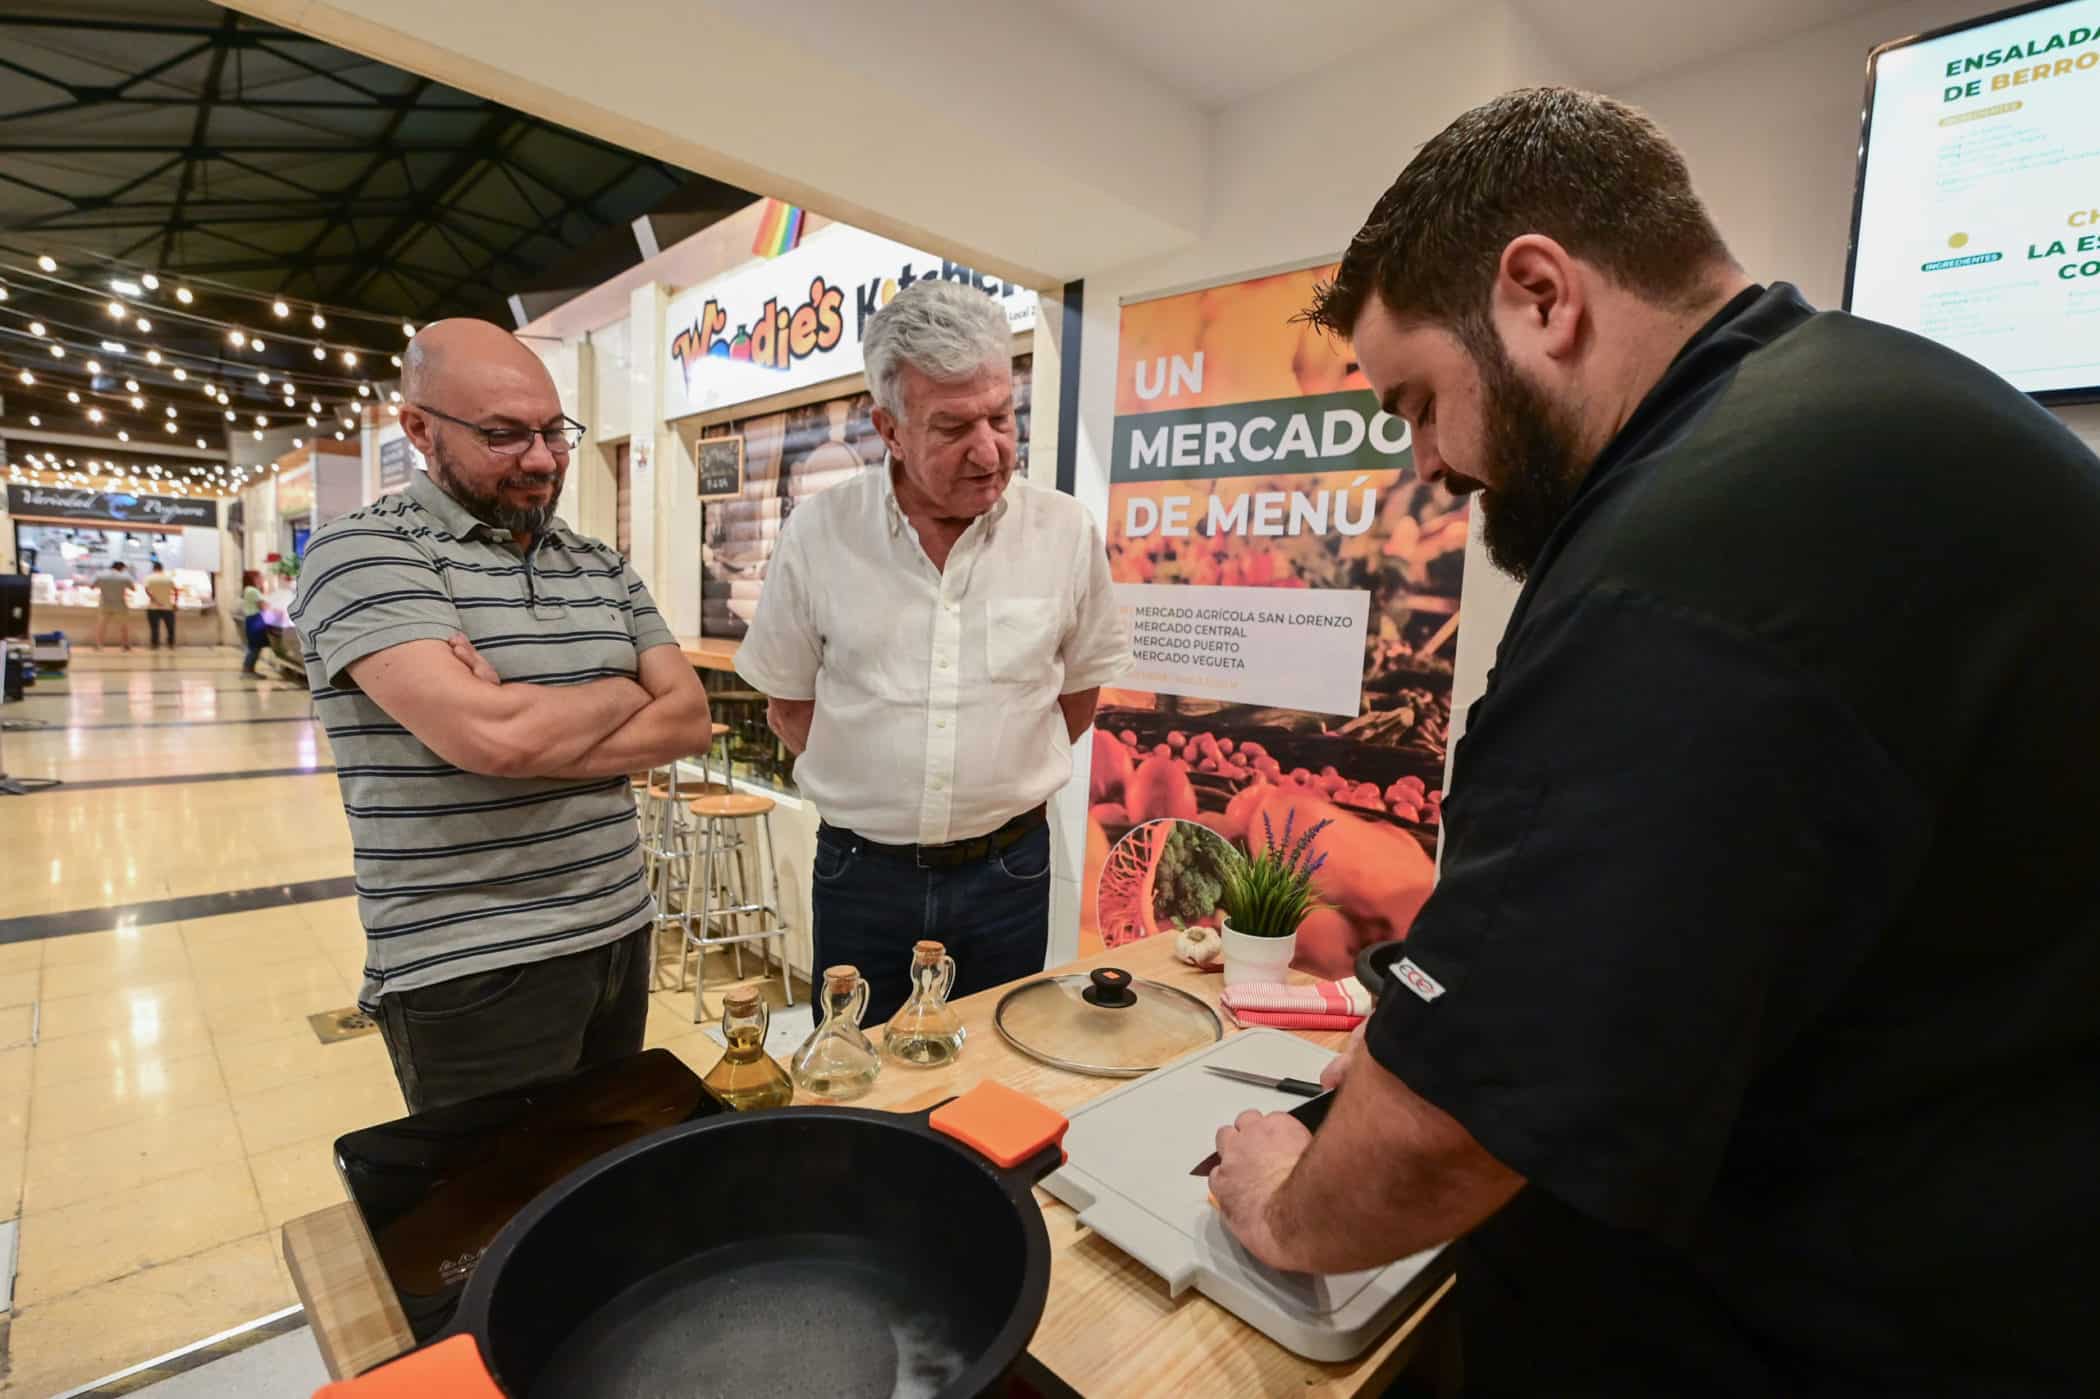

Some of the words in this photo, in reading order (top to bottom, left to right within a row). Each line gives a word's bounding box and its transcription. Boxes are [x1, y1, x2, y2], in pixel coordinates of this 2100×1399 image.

[1944, 80, 1981, 102] DE
[2027, 240, 2066, 260] LA
[2077, 234, 2100, 252] E
[1924, 252, 1999, 272] INGREDIENTES
[2058, 260, 2100, 280] CO
[1135, 351, 1205, 400] UN
[1129, 408, 1413, 470] MERCADO
[1125, 495, 1191, 537] DE
[1206, 475, 1377, 537] MENÚ
[1135, 606, 1194, 619] MERCADO
[1195, 607, 1255, 622] AGRÍCOLA
[1257, 612, 1285, 625] SAN
[1288, 614, 1353, 628] LORENZO
[1134, 621, 1192, 634] MERCADO
[1194, 624, 1248, 638] CENTRAL
[1133, 635, 1191, 649] MERCADO
[1193, 639, 1240, 653] PUERTO
[1132, 650, 1190, 664] MERCADO
[1192, 655, 1246, 669] VEGUETA
